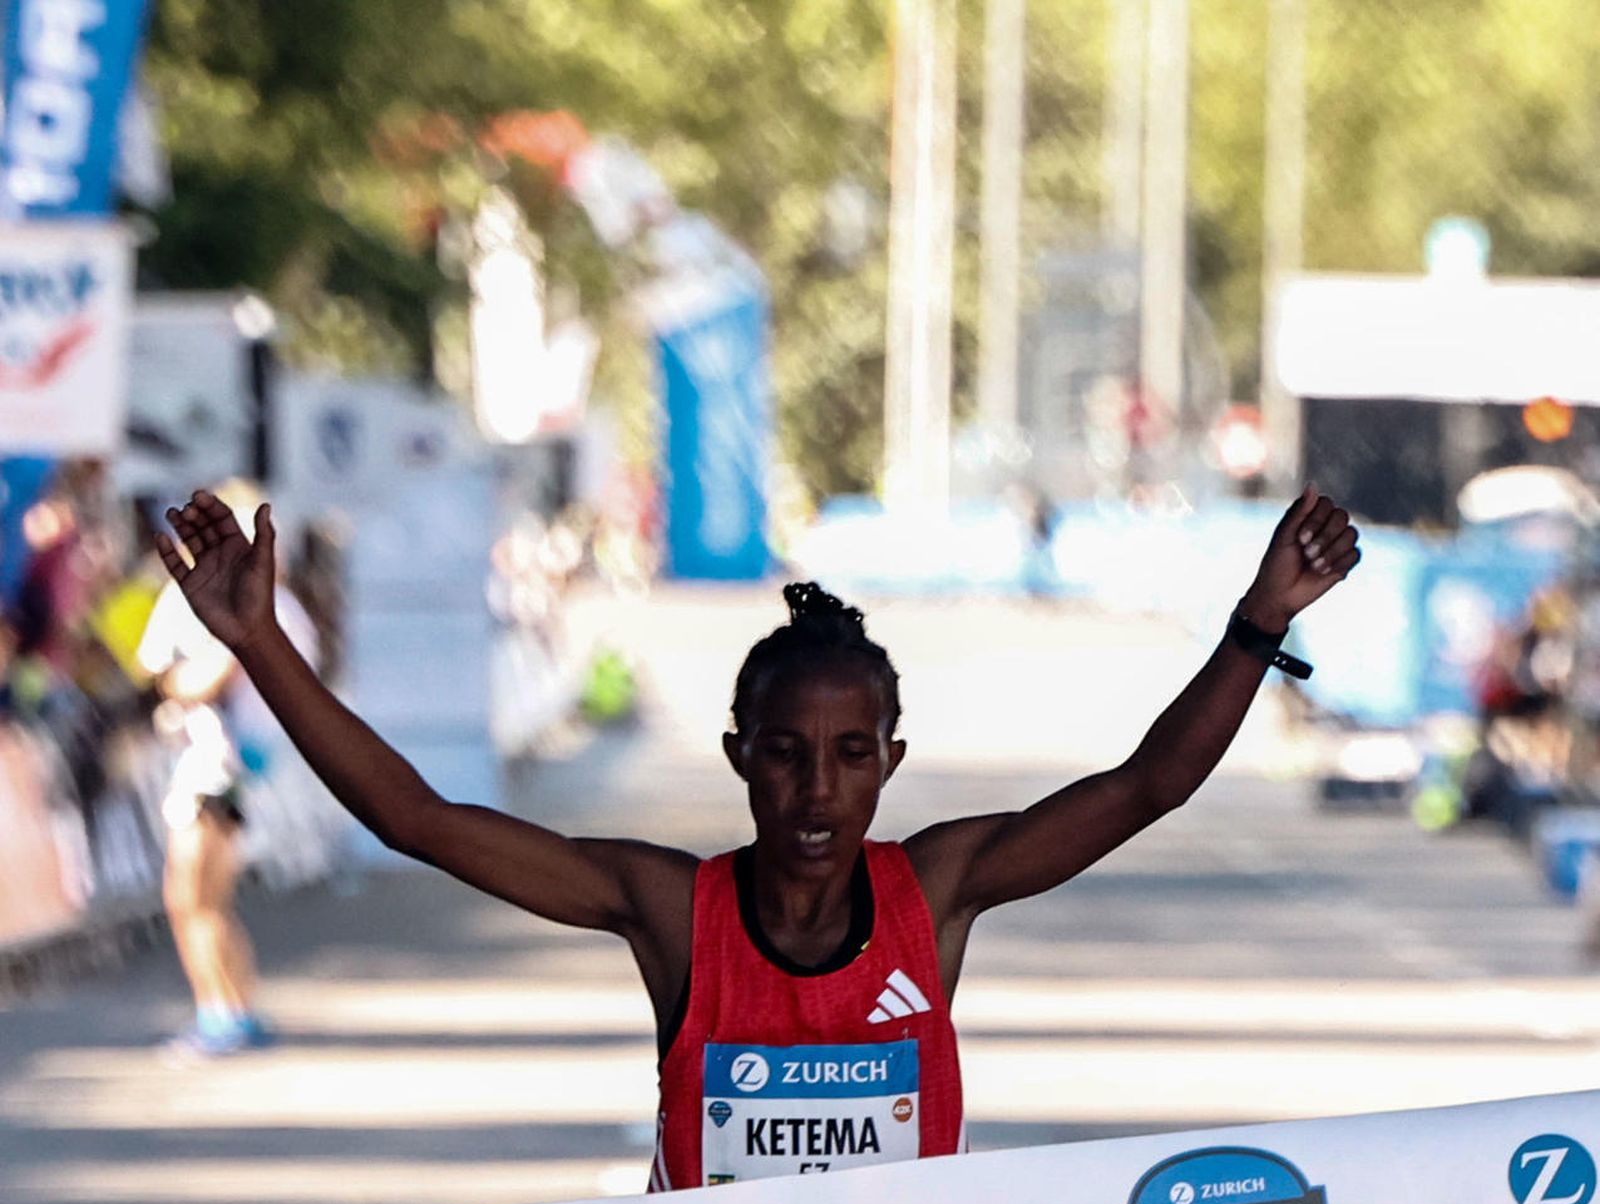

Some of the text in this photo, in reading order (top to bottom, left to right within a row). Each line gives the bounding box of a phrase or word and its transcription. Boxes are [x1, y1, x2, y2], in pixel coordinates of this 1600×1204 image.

[782, 1060, 888, 1084] ZURICH
[746, 1117, 881, 1156] KETEMA
[1202, 1178, 1265, 1199] ZURICH
